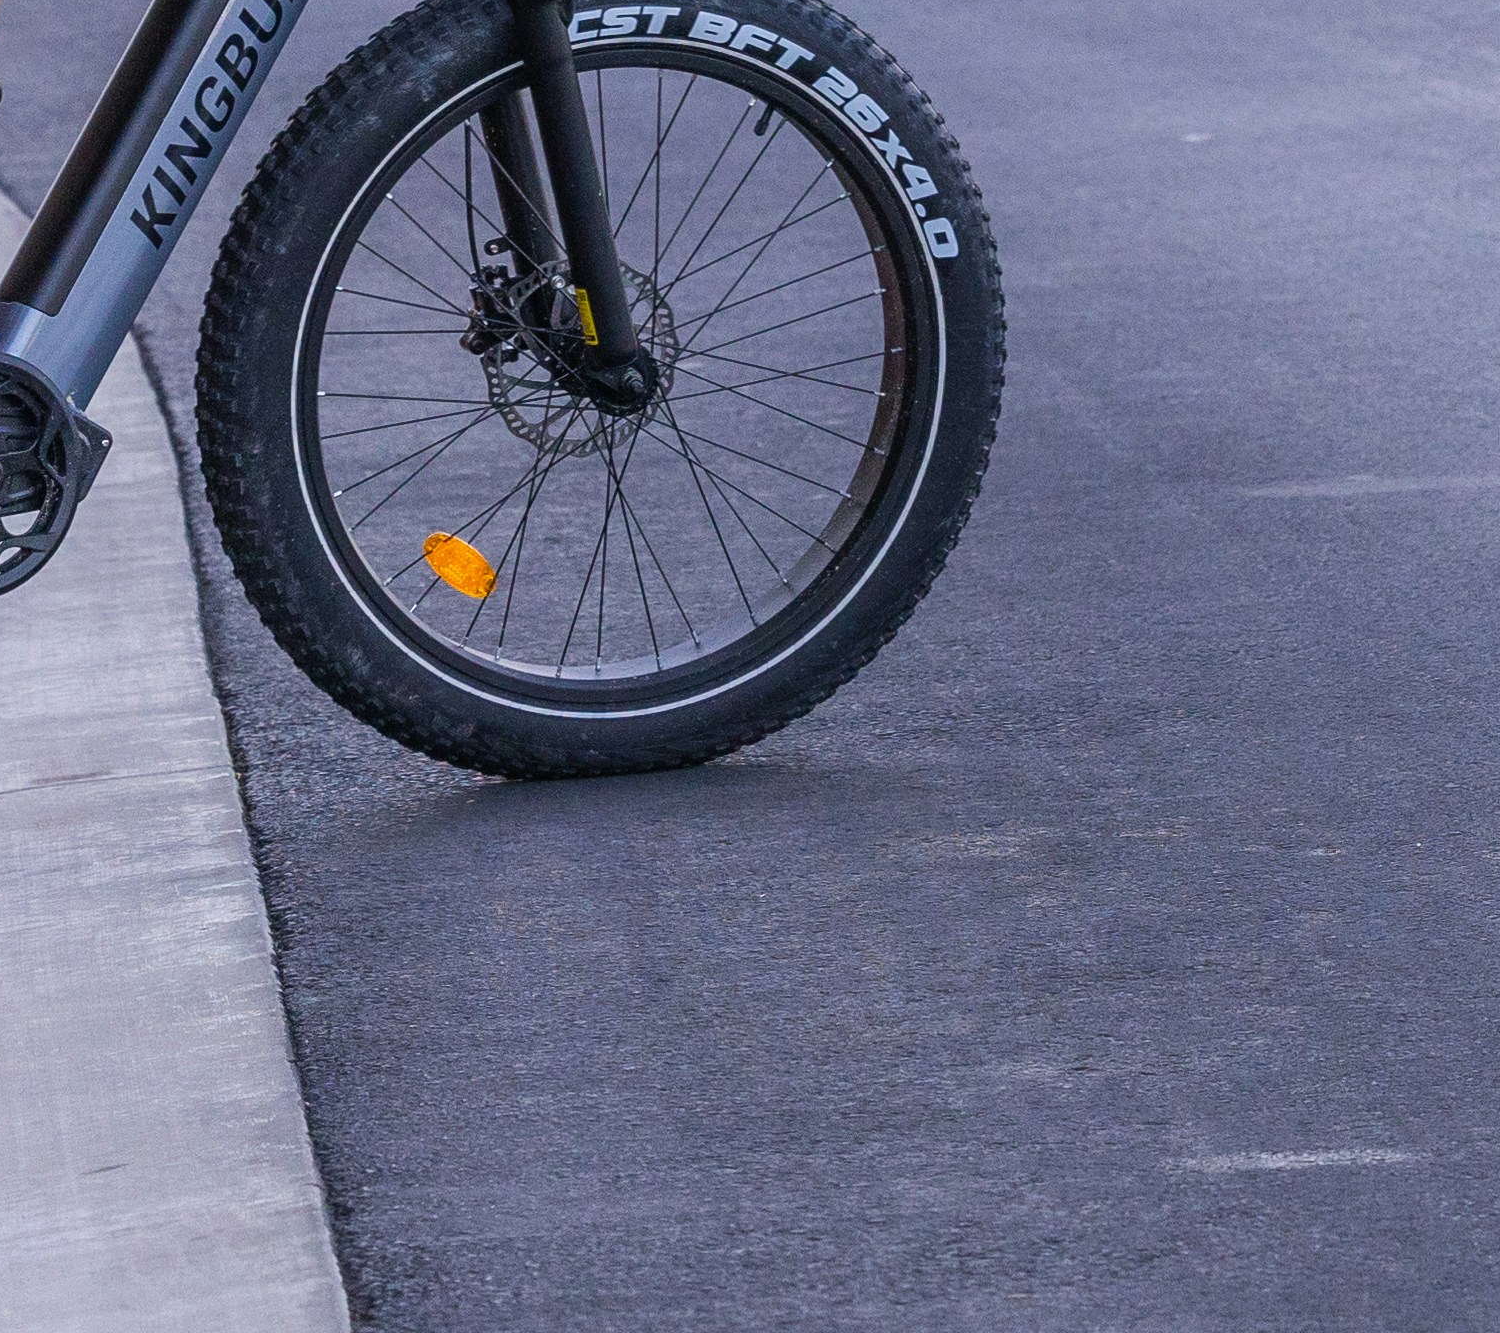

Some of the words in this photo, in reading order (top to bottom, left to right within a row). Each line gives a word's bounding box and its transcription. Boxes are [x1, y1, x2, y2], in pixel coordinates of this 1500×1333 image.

[567, 5, 681, 42] CST
[689, 10, 816, 70] BFT
[812, 66, 959, 259] 26x4.0
